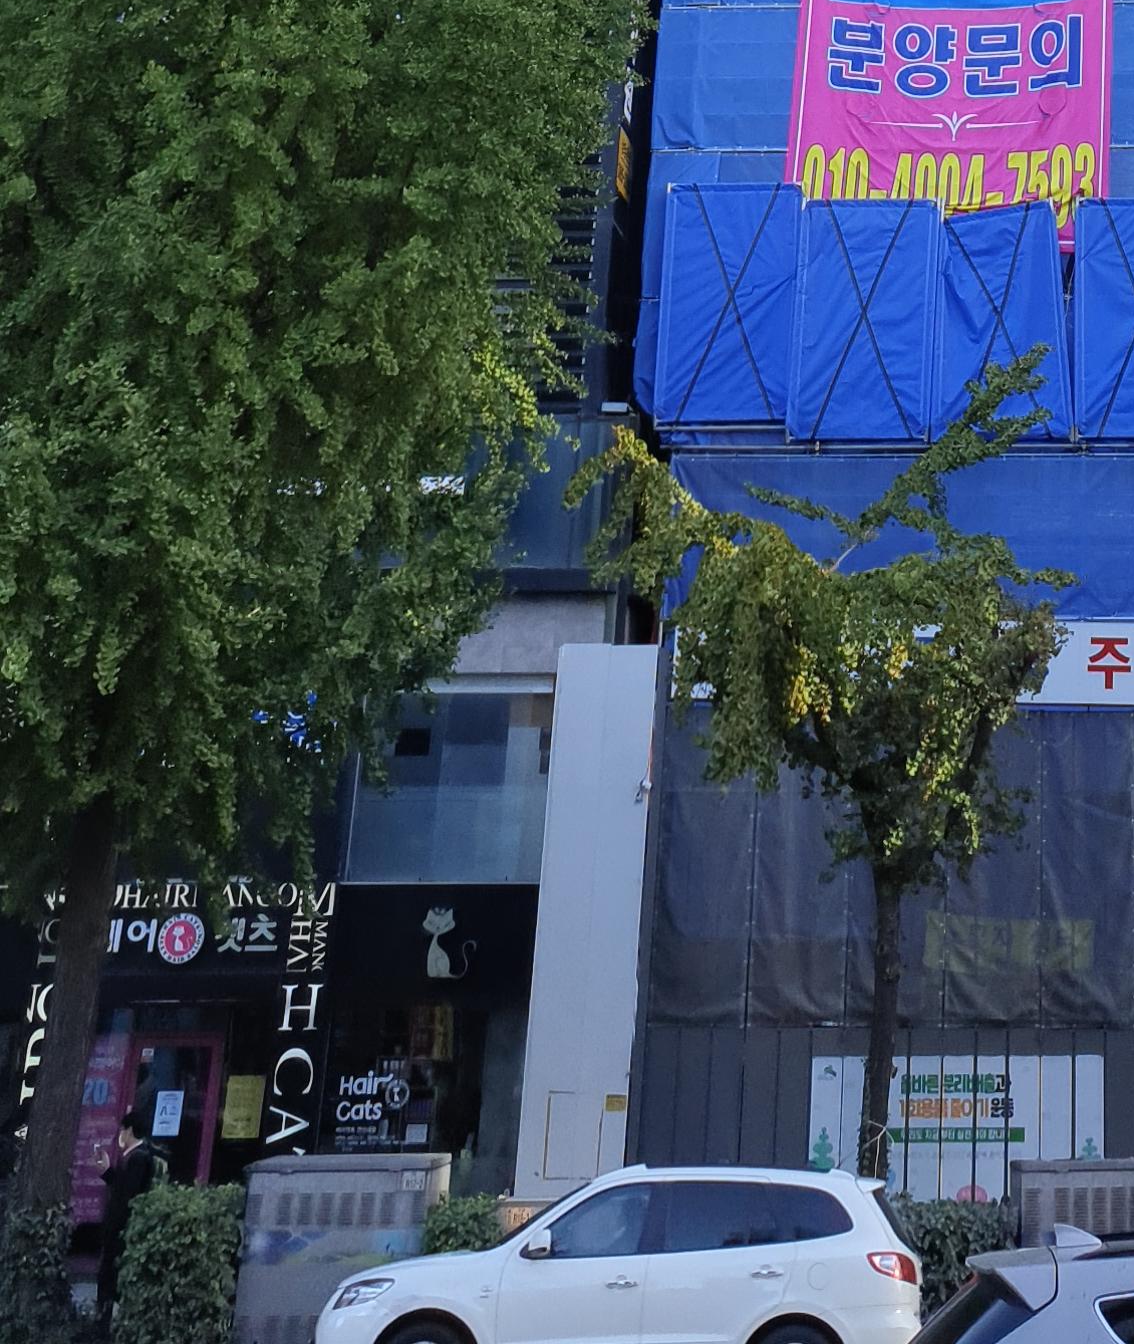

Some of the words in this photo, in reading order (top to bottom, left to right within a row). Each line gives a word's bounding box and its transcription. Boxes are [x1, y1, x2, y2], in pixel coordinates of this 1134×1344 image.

[827, 13, 1085, 100] 분양문의
[339, 1070, 393, 1096] Hair
[335, 1100, 382, 1122] Cats
